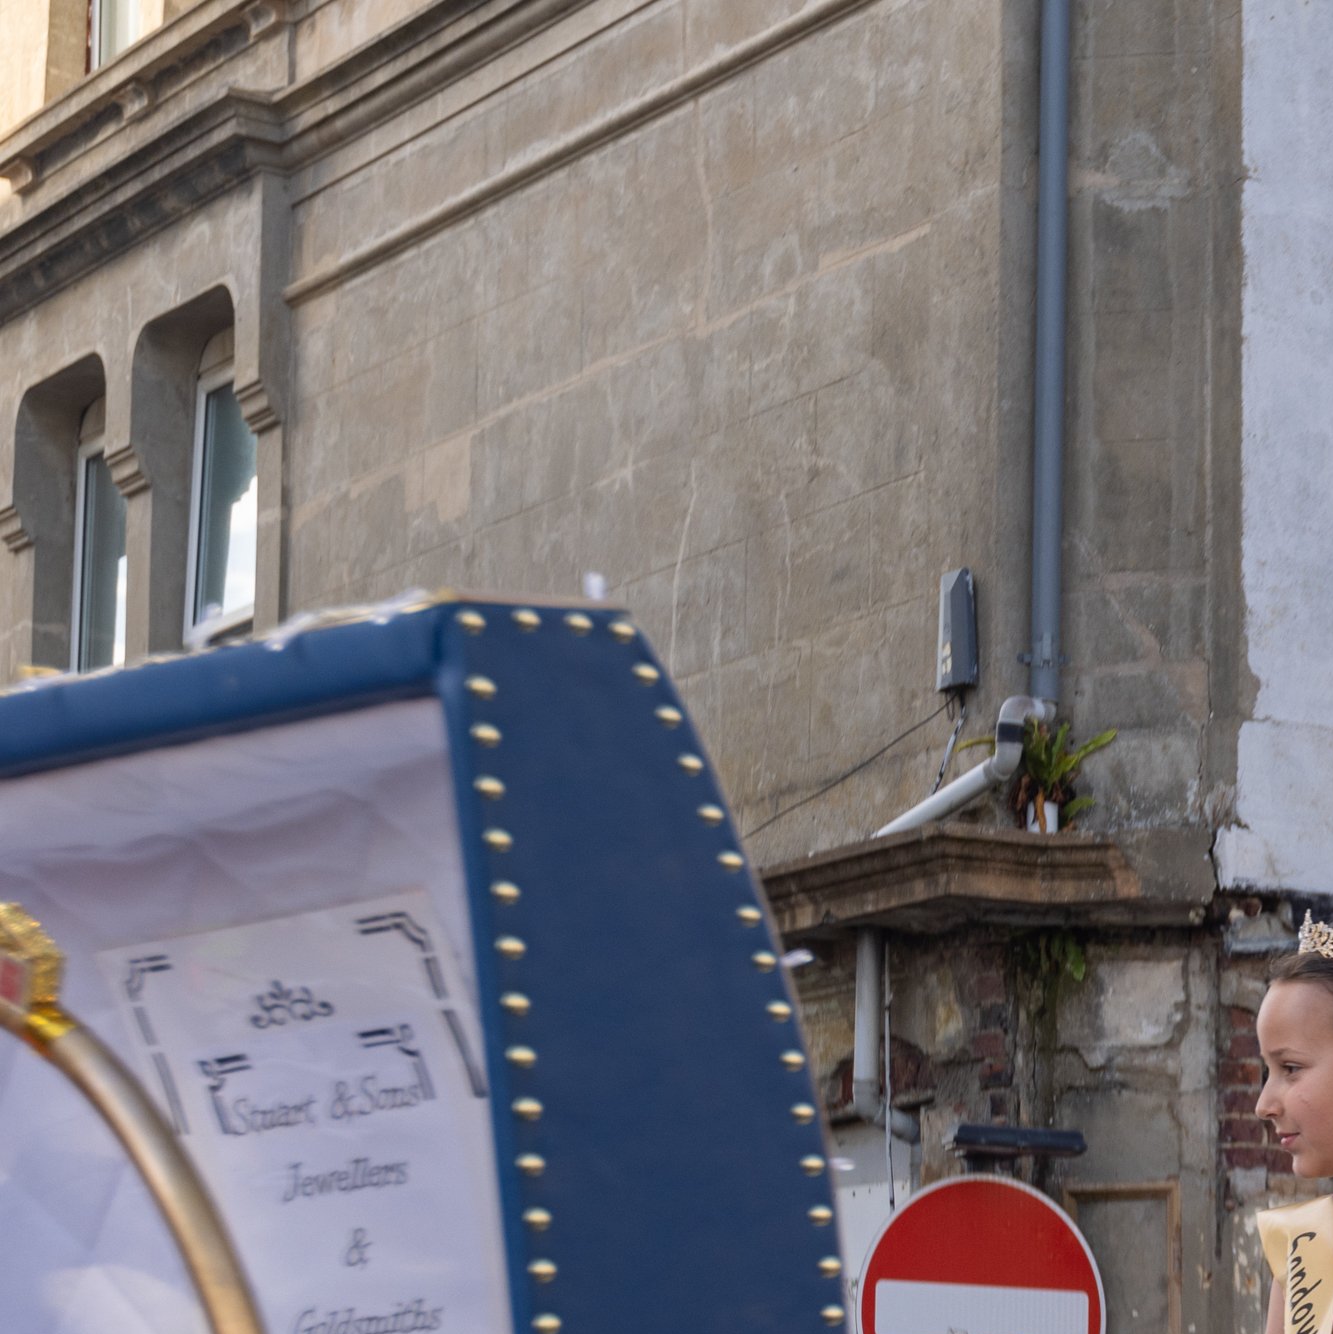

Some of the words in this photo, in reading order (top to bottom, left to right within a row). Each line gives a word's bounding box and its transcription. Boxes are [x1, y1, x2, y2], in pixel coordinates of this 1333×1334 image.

[230, 1094, 318, 1135] Stuart
[355, 1074, 422, 1116] Sons
[281, 1157, 410, 1203] Jewellers
[343, 1227, 375, 1268] &
